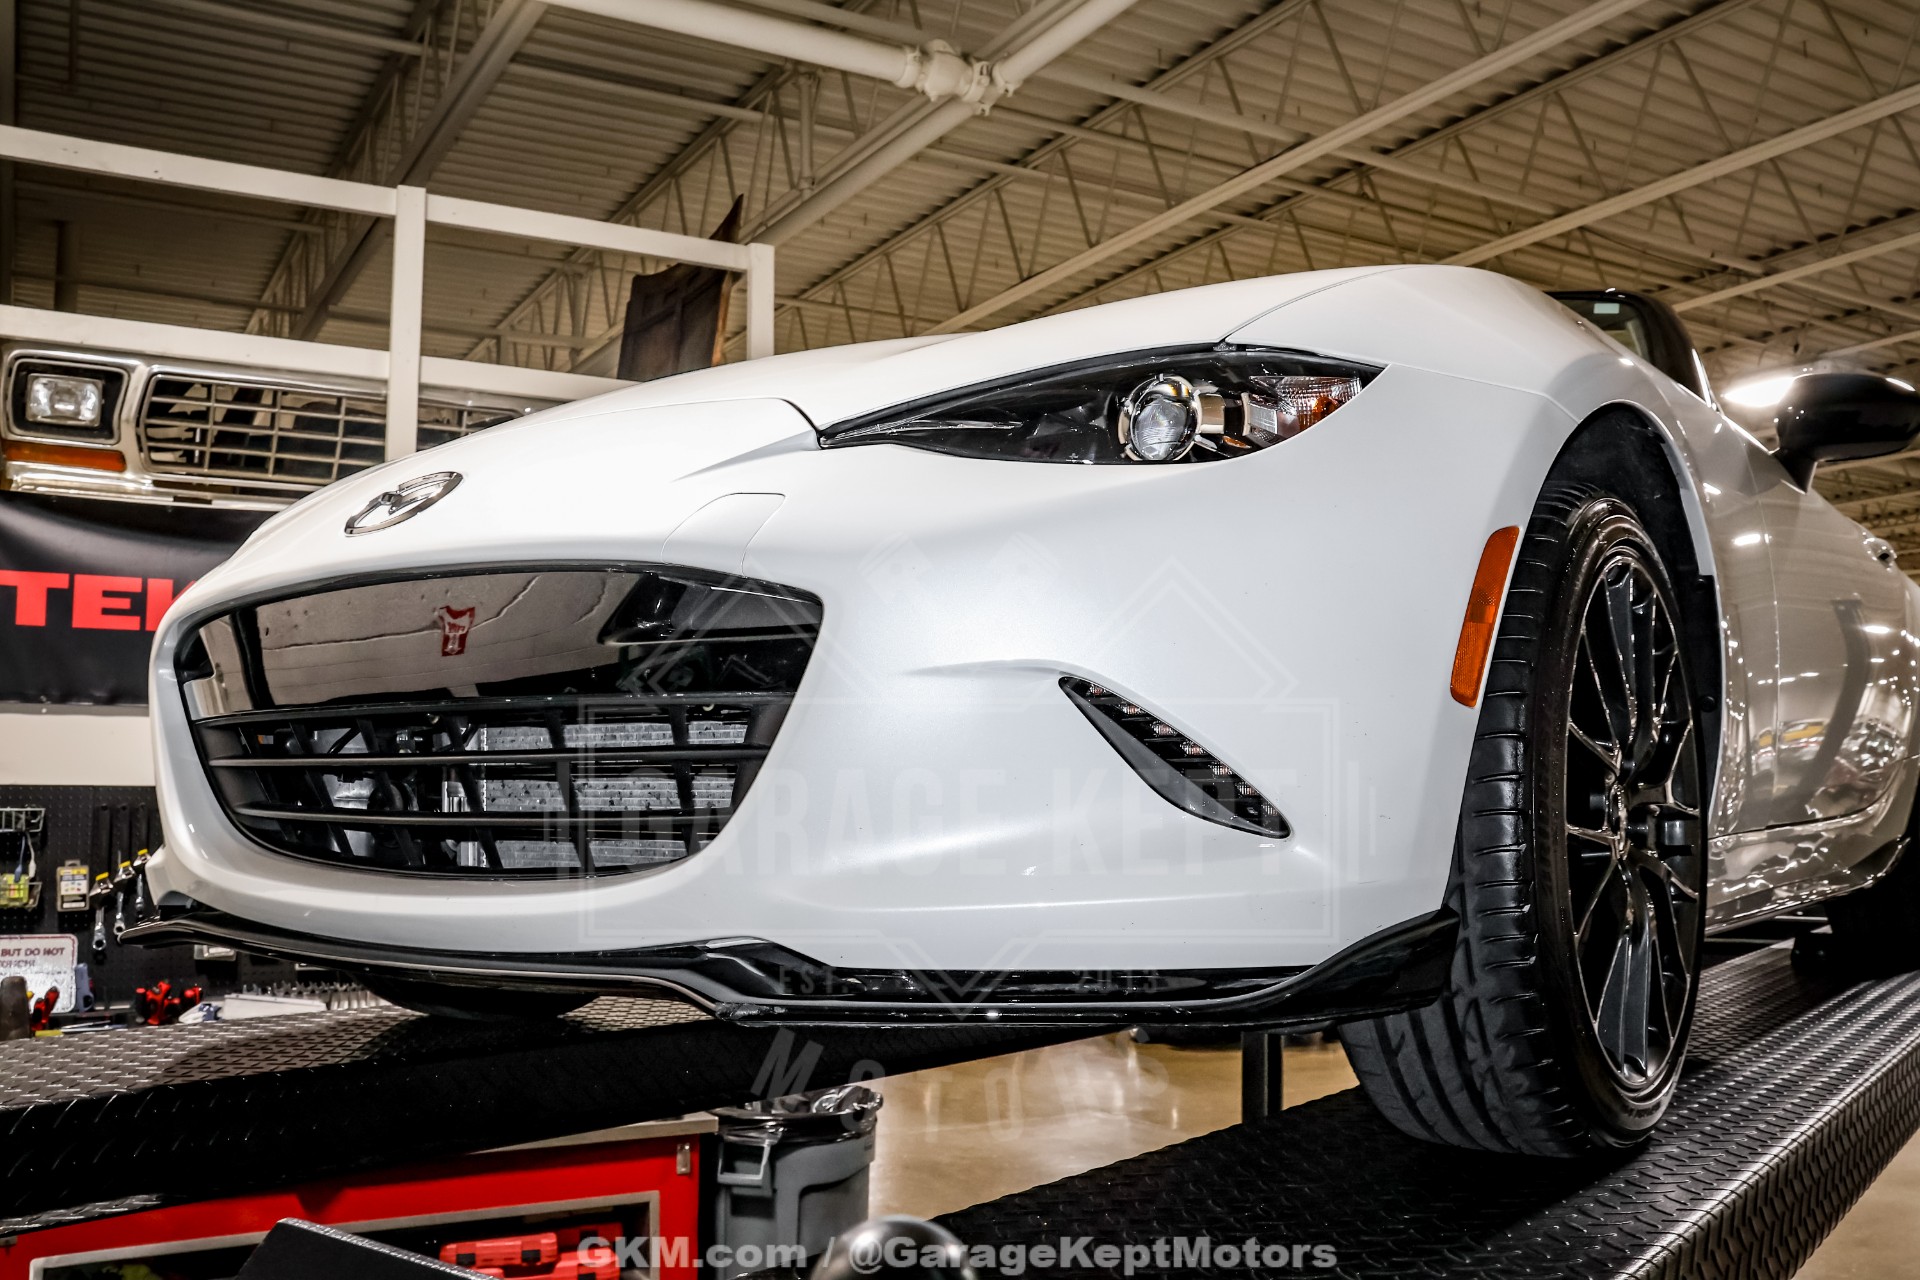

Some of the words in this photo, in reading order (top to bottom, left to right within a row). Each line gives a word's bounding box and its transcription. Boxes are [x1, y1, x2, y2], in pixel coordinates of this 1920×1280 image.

[1, 948, 22, 957] BUT
[25, 948, 40, 956] DO
[43, 947, 65, 956] NOT
